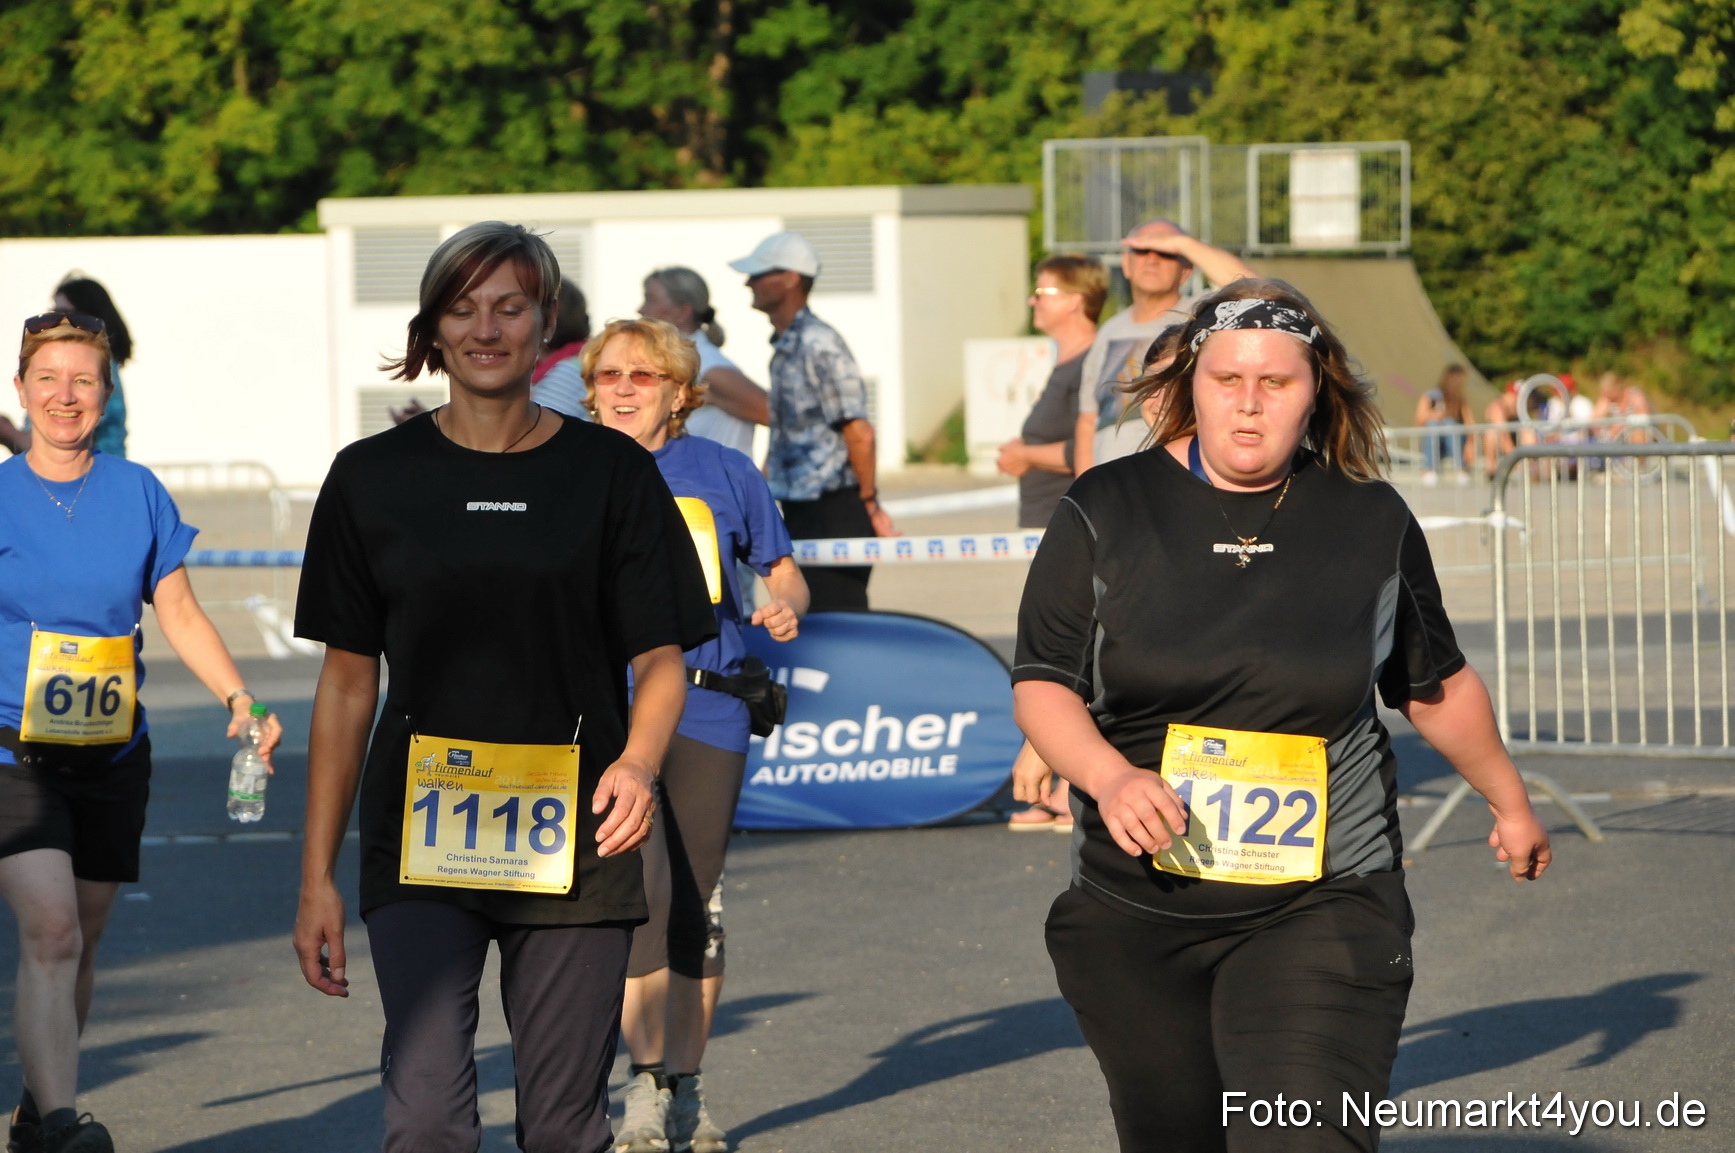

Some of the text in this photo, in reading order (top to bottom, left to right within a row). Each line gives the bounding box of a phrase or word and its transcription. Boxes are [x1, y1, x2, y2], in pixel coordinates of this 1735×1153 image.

[466, 501, 527, 512] STANNO
[44, 673, 122, 717] 616
[750, 704, 978, 761] ischer
[1189, 750, 1248, 767] firmenlauf
[435, 762, 495, 778] firmenlauf
[750, 754, 959, 786] AUTOMOBILE
[1172, 766, 1217, 782] walken
[417, 777, 464, 791] walken
[1173, 779, 1318, 848] 1122
[412, 790, 567, 855] 1118
[1198, 843, 1280, 859] Christina Schuster
[446, 853, 528, 866] Christine Samaras
[1189, 855, 1286, 873] Regens Wagner Stiftung
[437, 865, 536, 879] Regens Wagner Stiftung
